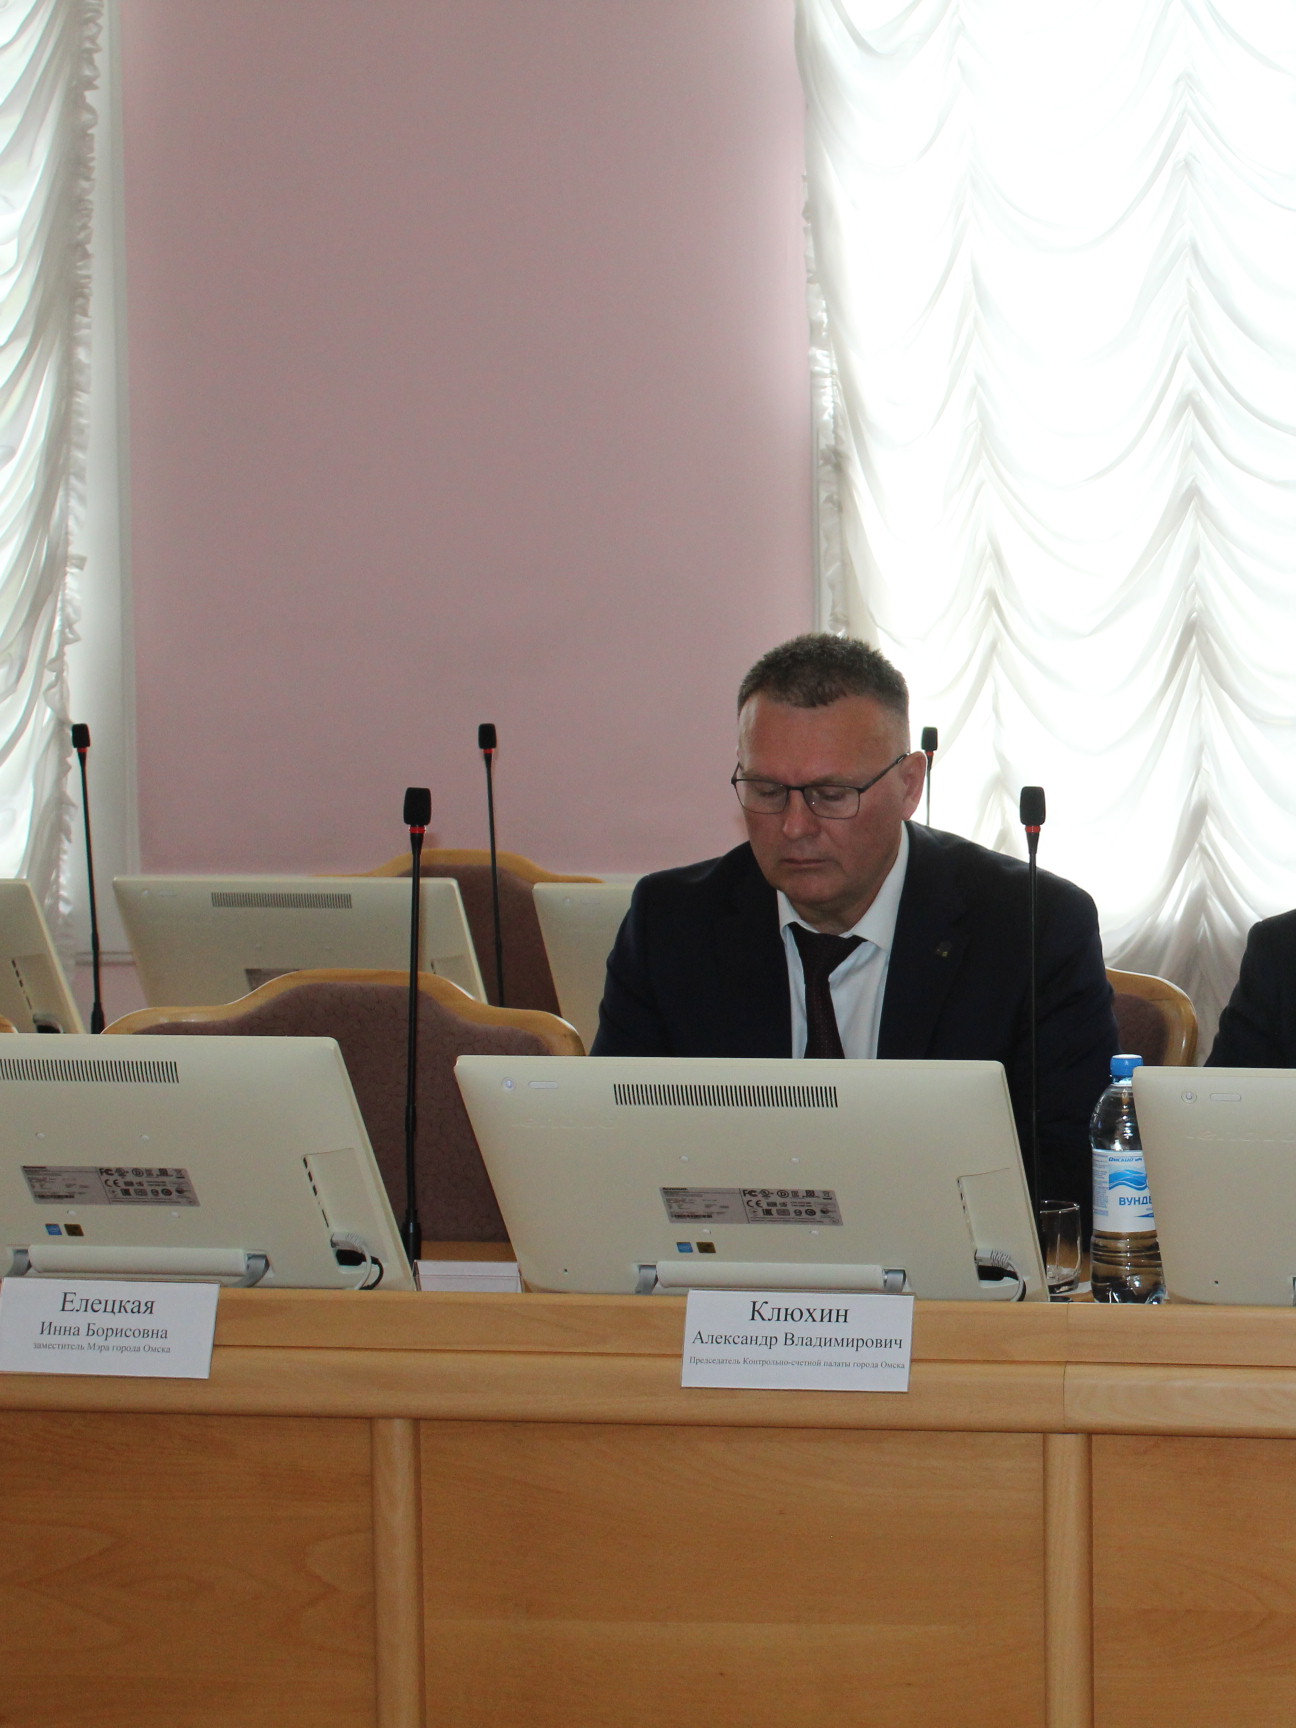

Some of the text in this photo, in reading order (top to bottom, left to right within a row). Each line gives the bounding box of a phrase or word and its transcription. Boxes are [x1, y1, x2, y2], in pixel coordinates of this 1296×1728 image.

[60, 1292, 155, 1315] Елецкая
[749, 1300, 850, 1324] Клюхин
[40, 1321, 168, 1340] Инна Борисовна
[33, 1342, 170, 1354] заместитель Мэра города Омска
[692, 1330, 902, 1352] Александр Владимирович
[690, 1356, 740, 1365] Председатель
[824, 1360, 850, 1368] палаты
[853, 1362, 878, 1370] города
[880, 1360, 905, 1369] Омска
